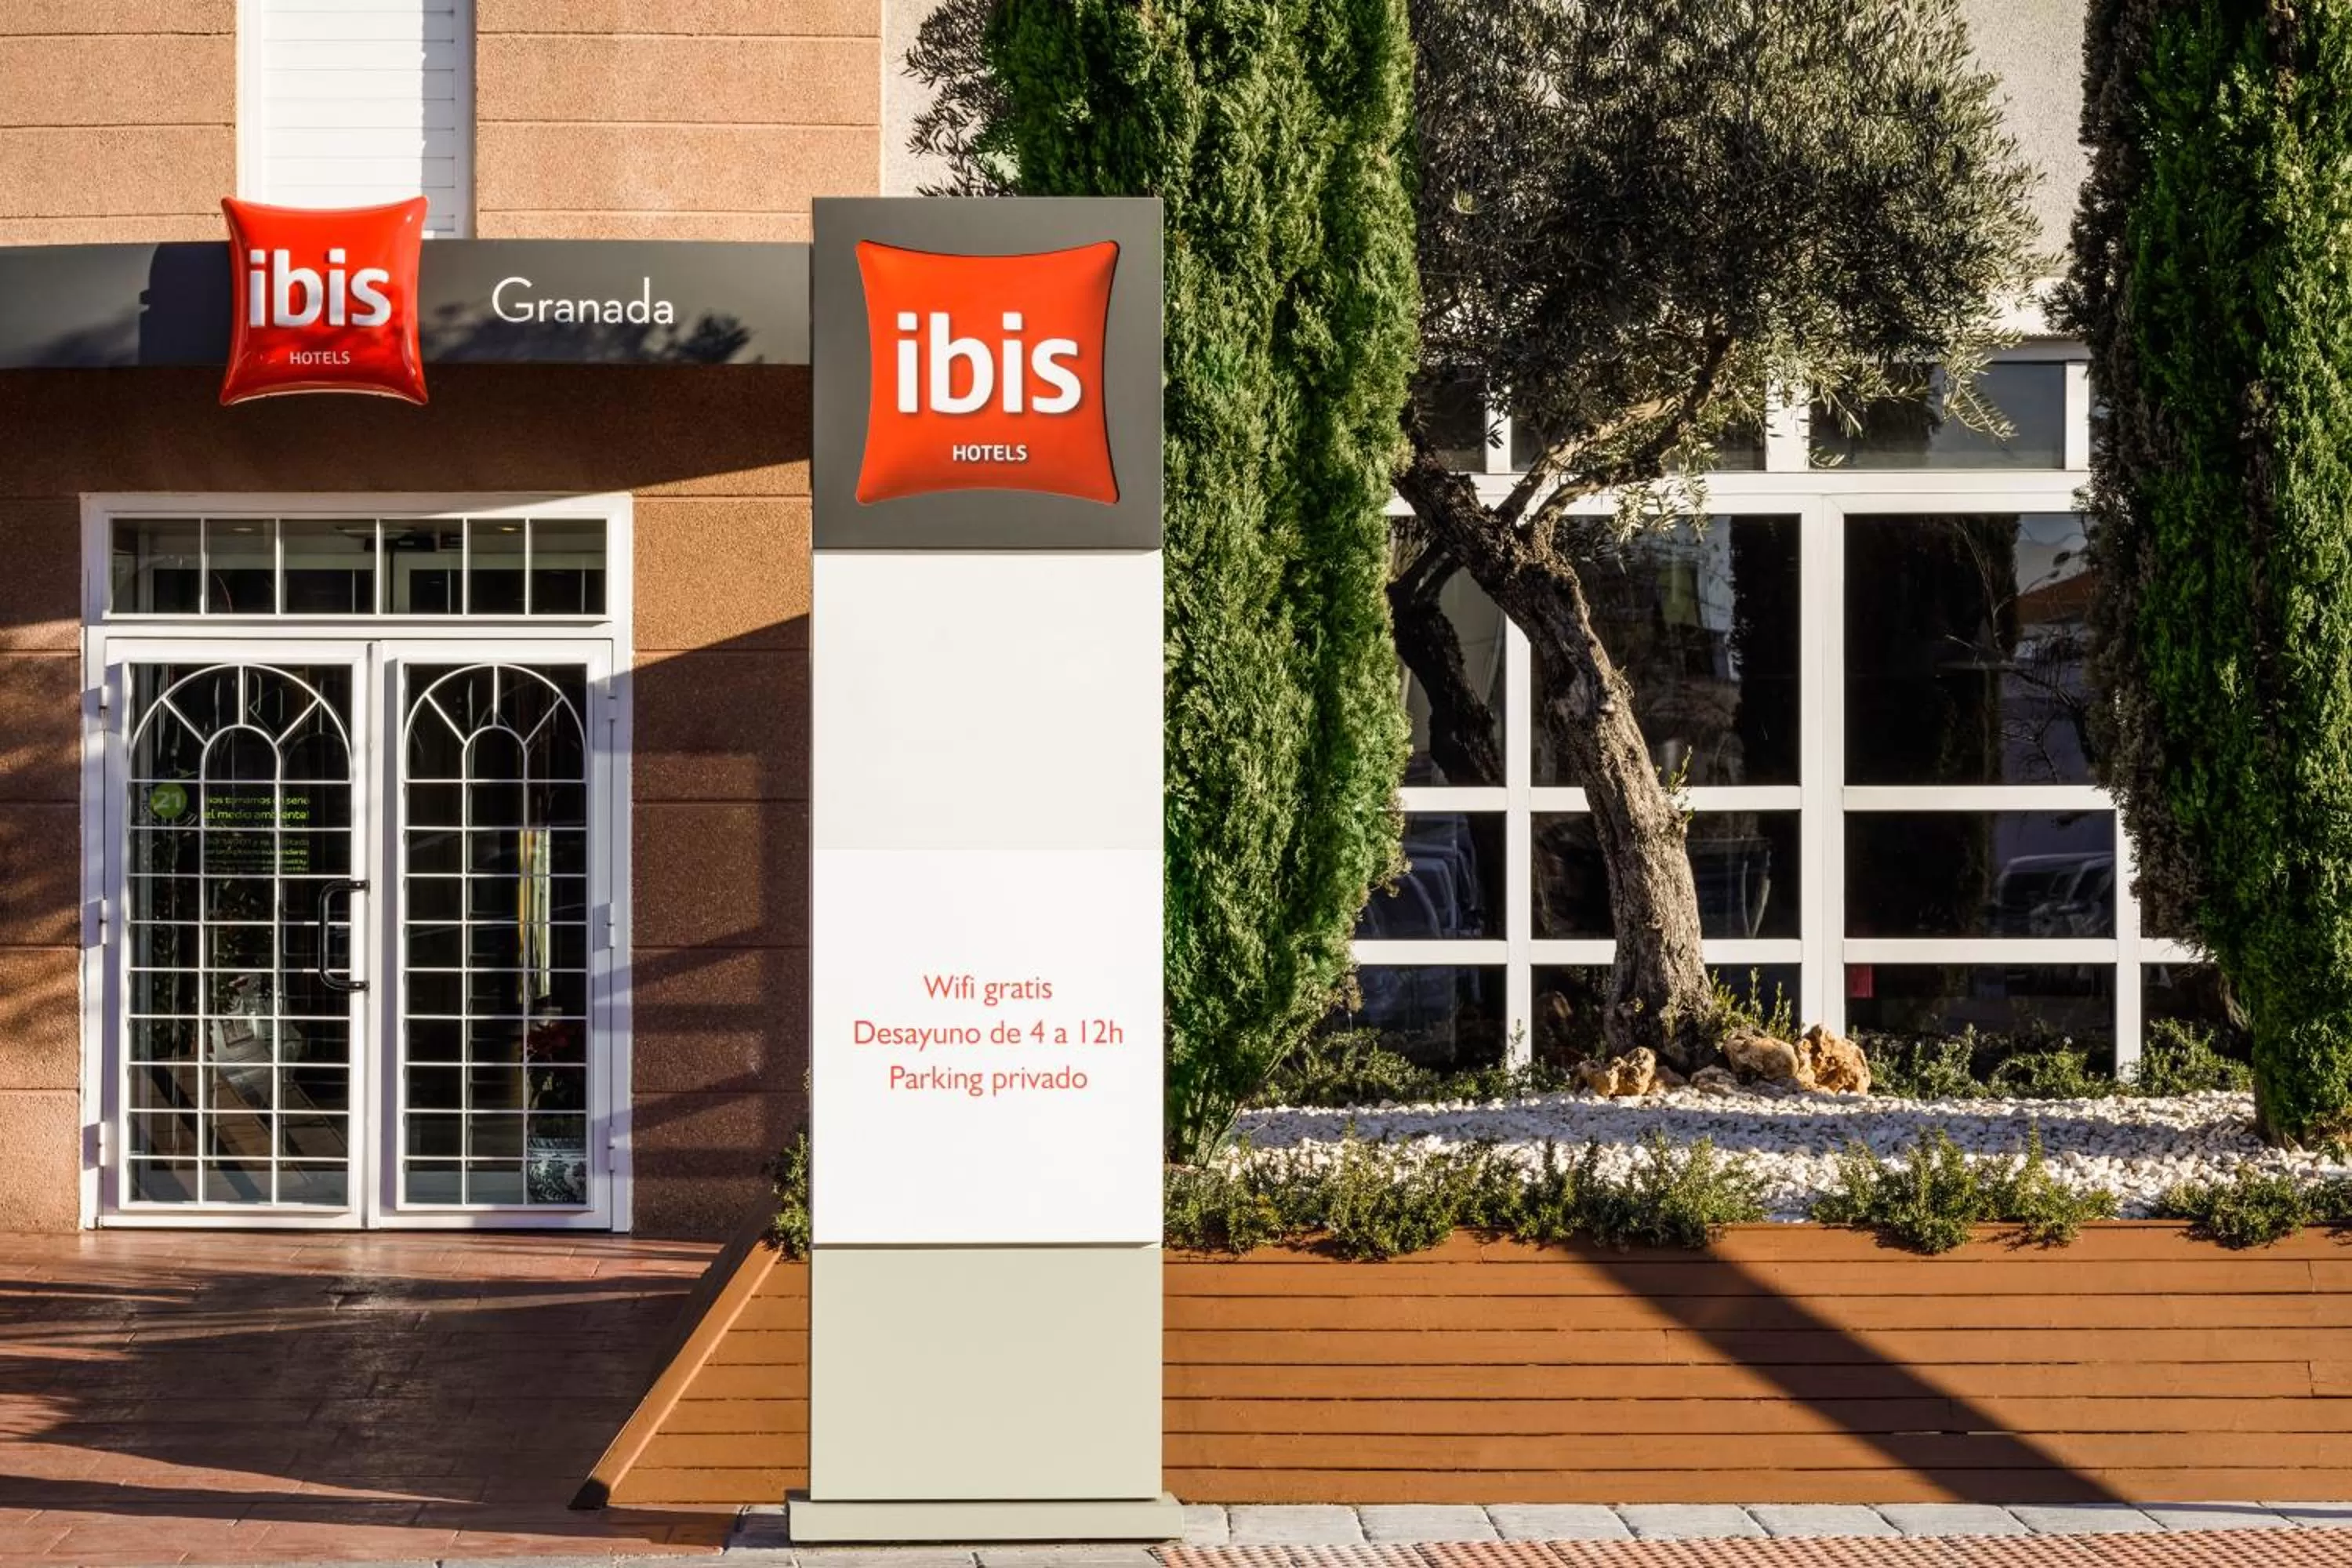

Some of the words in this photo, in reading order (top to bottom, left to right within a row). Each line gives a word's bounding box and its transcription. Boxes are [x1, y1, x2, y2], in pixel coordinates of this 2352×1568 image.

[251, 249, 392, 327] ibis
[492, 276, 674, 325] Granada
[289, 350, 350, 365] HOTELS
[897, 312, 1081, 414] ibis
[953, 445, 1028, 461] HOTELS
[153, 791, 181, 809] 21
[923, 975, 975, 1000] Wifi
[983, 976, 1053, 1007] gratis
[854, 1019, 982, 1052] Desayuno
[989, 1020, 1022, 1044] de
[1029, 1020, 1046, 1044] 4
[1054, 1027, 1069, 1044] a
[1081, 1018, 1124, 1044] 12h
[890, 1065, 985, 1097] Parking
[993, 1065, 1088, 1097] privado
